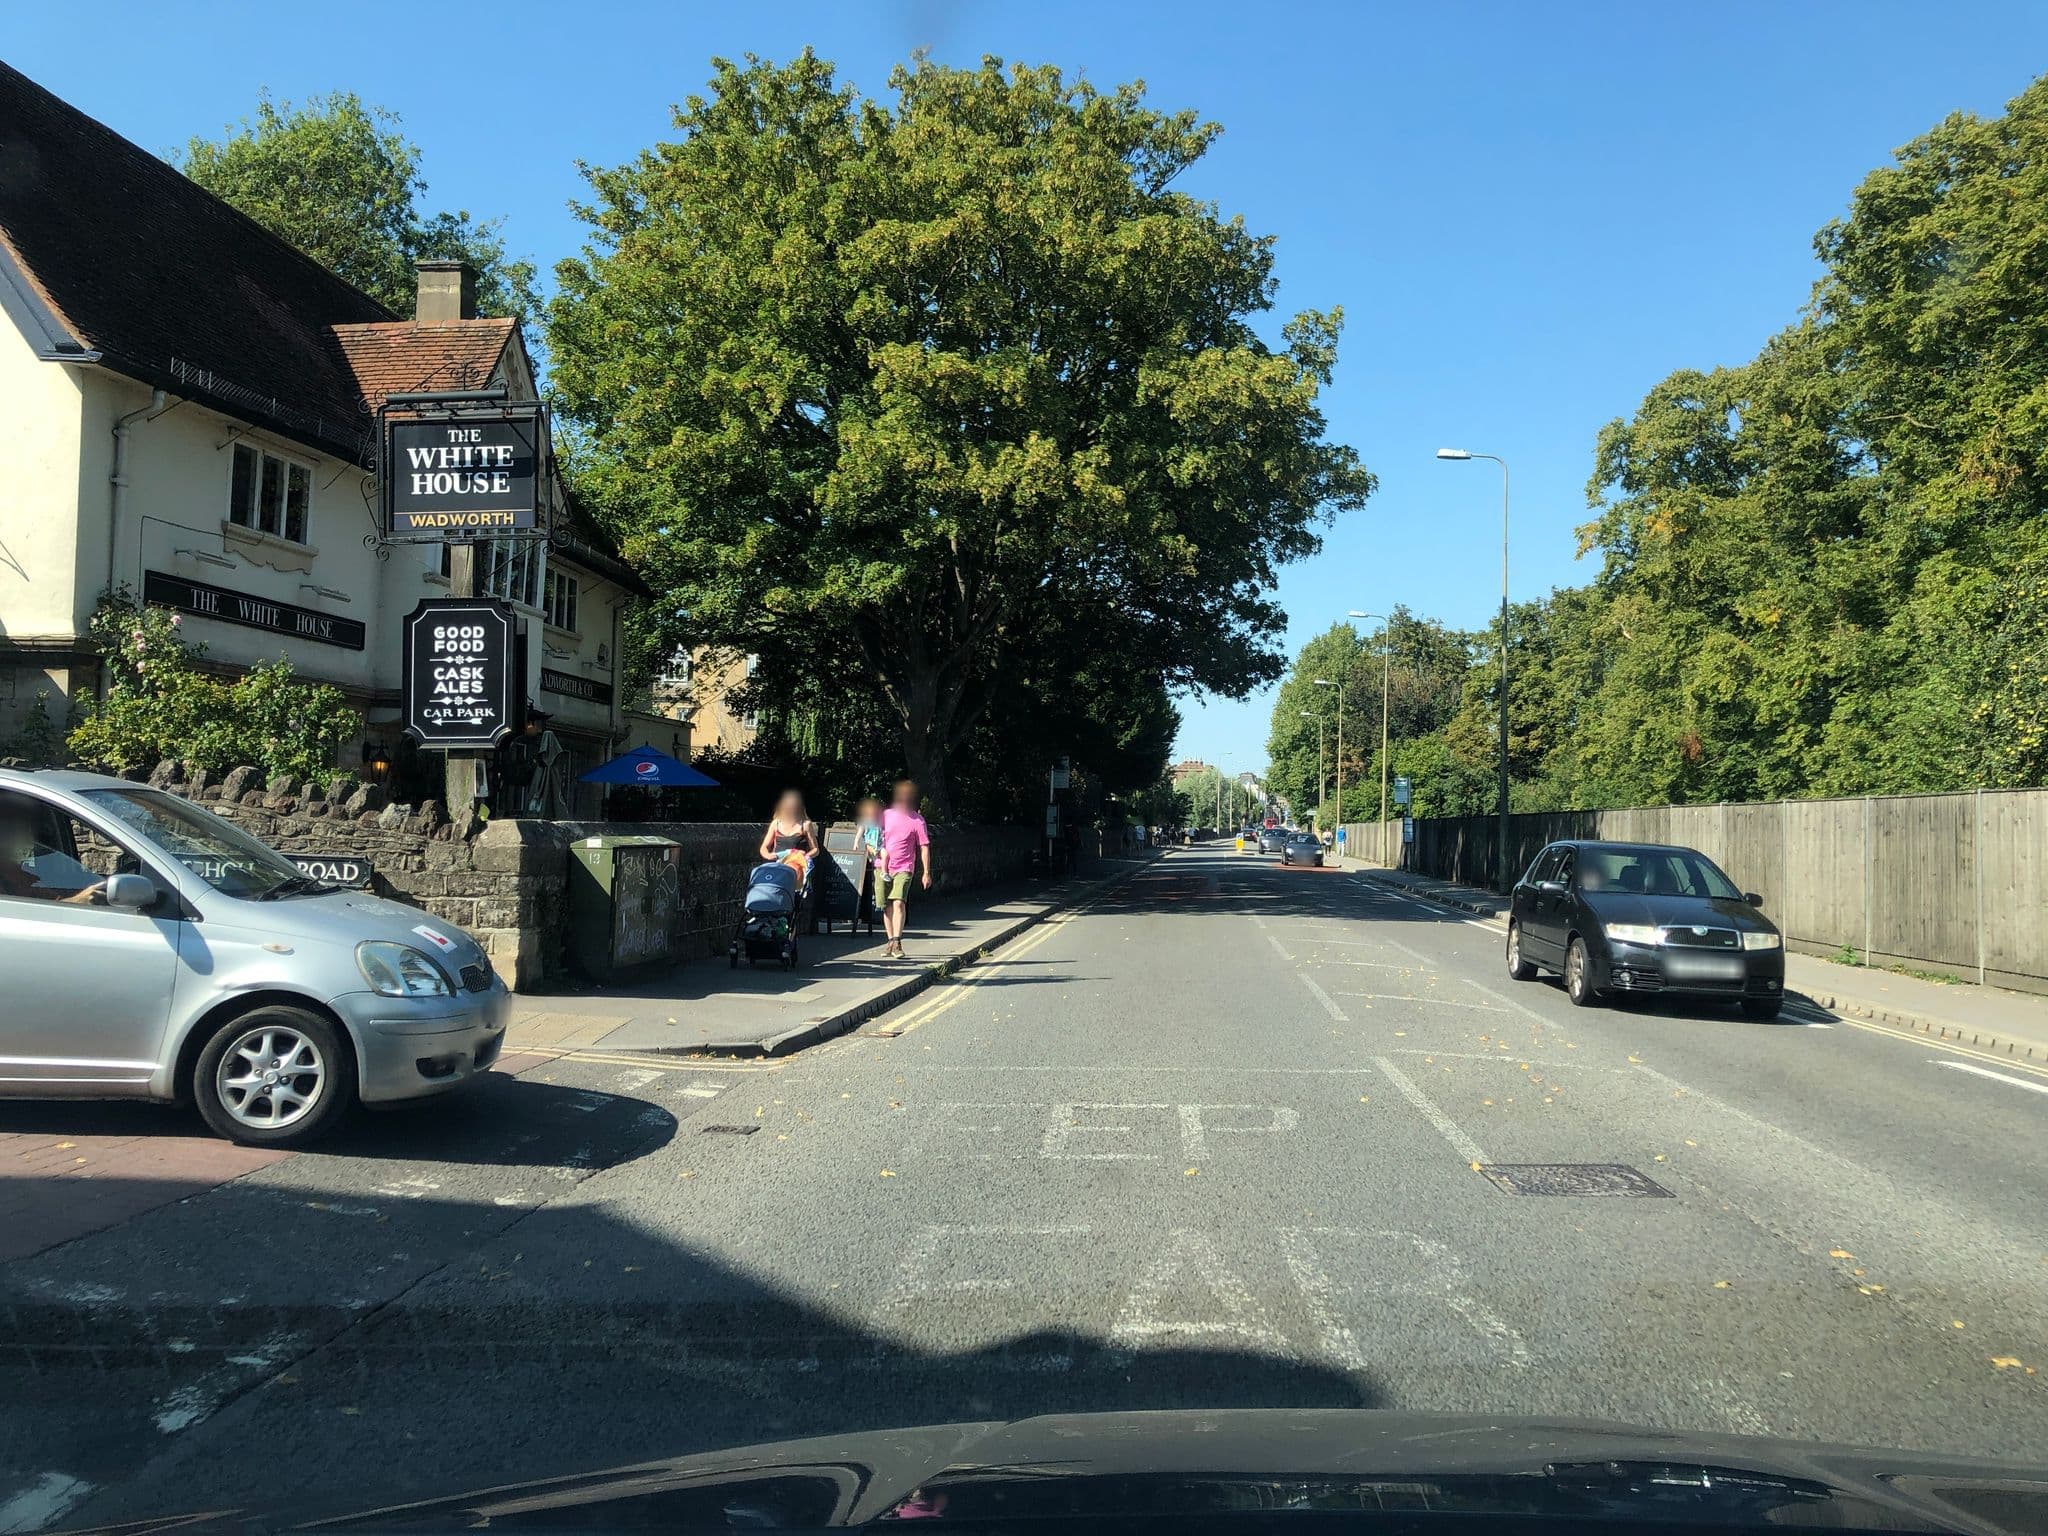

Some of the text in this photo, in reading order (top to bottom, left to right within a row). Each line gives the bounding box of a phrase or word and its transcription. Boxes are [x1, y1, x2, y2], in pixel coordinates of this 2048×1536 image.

[448, 429, 481, 443] THE
[407, 445, 514, 469] WHITE
[411, 471, 511, 495] HOUSE
[409, 512, 514, 527] WADWORTH
[191, 588, 334, 639] THE WHITE HOUSE
[433, 626, 485, 639] GOOD
[433, 640, 485, 653] FOOD
[433, 667, 485, 680] CASK
[433, 681, 484, 694] ALES
[543, 673, 577, 694] ADWORTH
[423, 707, 496, 718] CAR PARK
